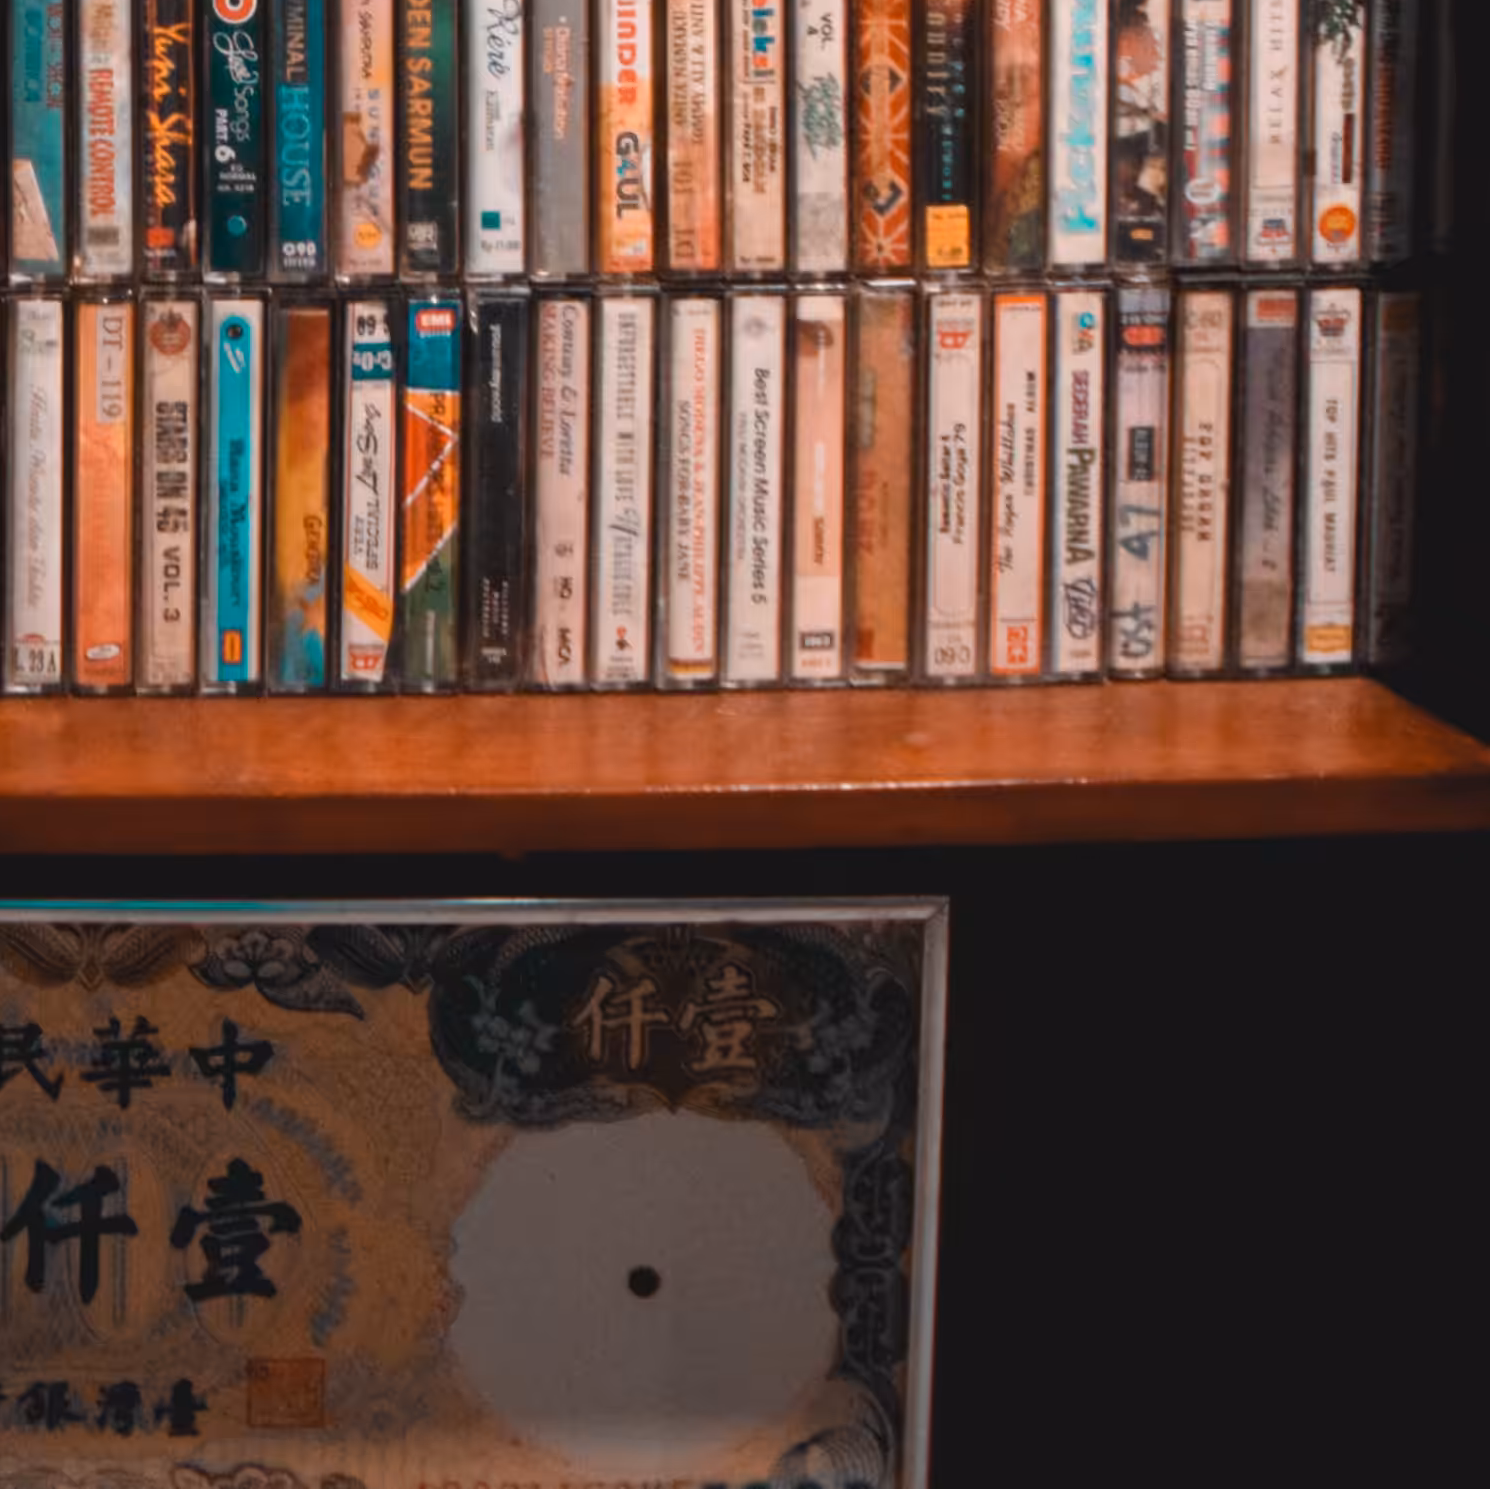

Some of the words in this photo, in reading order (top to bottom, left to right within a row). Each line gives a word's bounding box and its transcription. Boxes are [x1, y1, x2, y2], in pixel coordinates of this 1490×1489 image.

[151, 23, 194, 100] Yuni
[148, 110, 193, 210] Shara
[283, 84, 310, 206] HOUSE
[406, 67, 433, 191] SARMUN
[751, 368, 771, 405] Best
[751, 409, 771, 473] Screen
[751, 478, 771, 532] Music
[1066, 447, 1096, 566] PAWARNA
[751, 537, 771, 589] Series
